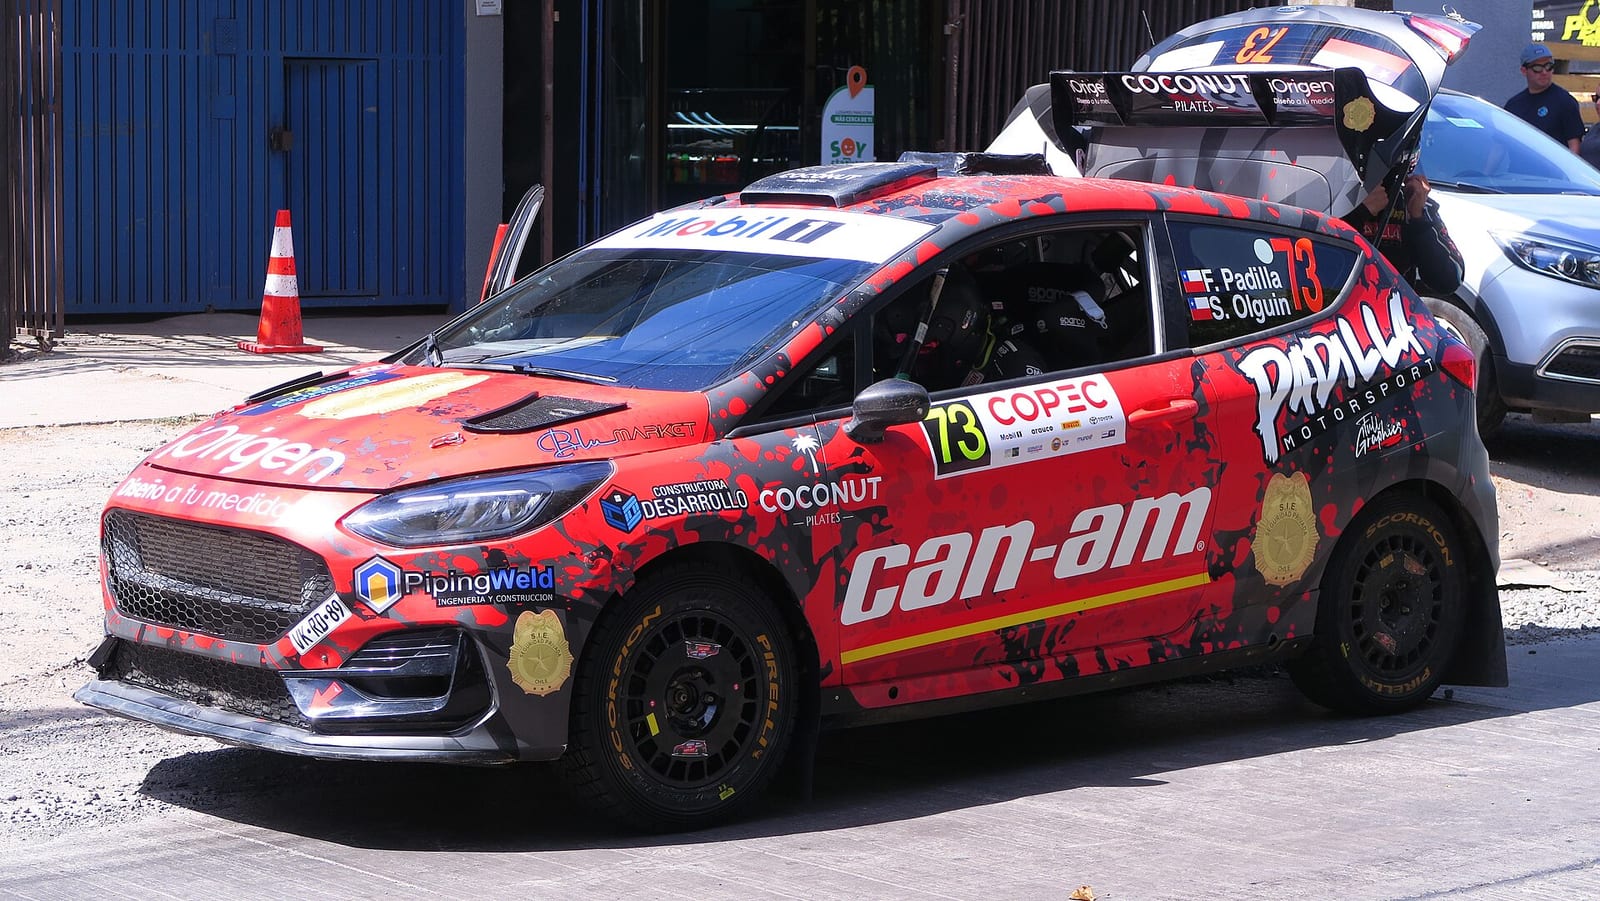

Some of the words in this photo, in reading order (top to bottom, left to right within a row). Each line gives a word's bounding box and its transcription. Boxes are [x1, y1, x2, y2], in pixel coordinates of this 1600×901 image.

[1121, 74, 1251, 94] COCONUT
[1265, 77, 1335, 97] iOrigen
[1174, 101, 1214, 113] PILATES
[633, 215, 790, 239] Mobil
[1201, 269, 1220, 292] F.
[1220, 266, 1283, 292] Padilla
[1269, 237, 1324, 313] 73
[1209, 295, 1230, 321] S.
[1232, 292, 1292, 324] Olguin
[1237, 291, 1425, 464] PADILLA
[988, 380, 1108, 426] COPEC
[1283, 358, 1434, 451] MOTORSPORT
[924, 403, 986, 464] 73
[154, 425, 346, 483] iOrigen
[165, 483, 180, 502] a
[183, 482, 204, 504] tu
[653, 479, 728, 497] CONSTRUCTORA
[759, 476, 882, 513] COCONUT
[641, 490, 748, 519] DESARROLLO
[805, 513, 841, 527] PILATES
[1365, 512, 1454, 567] SCORPION
[840, 486, 1212, 626] can-am
[404, 567, 554, 595] PipingWeld
[438, 596, 486, 606] INGENIERIA
[488, 595, 494, 603] Y
[496, 593, 554, 603] CONSTRUCCION
[607, 604, 663, 771] SCORPION
[756, 634, 780, 748] PIRELLI
[1360, 665, 1432, 695] PIRELLI
